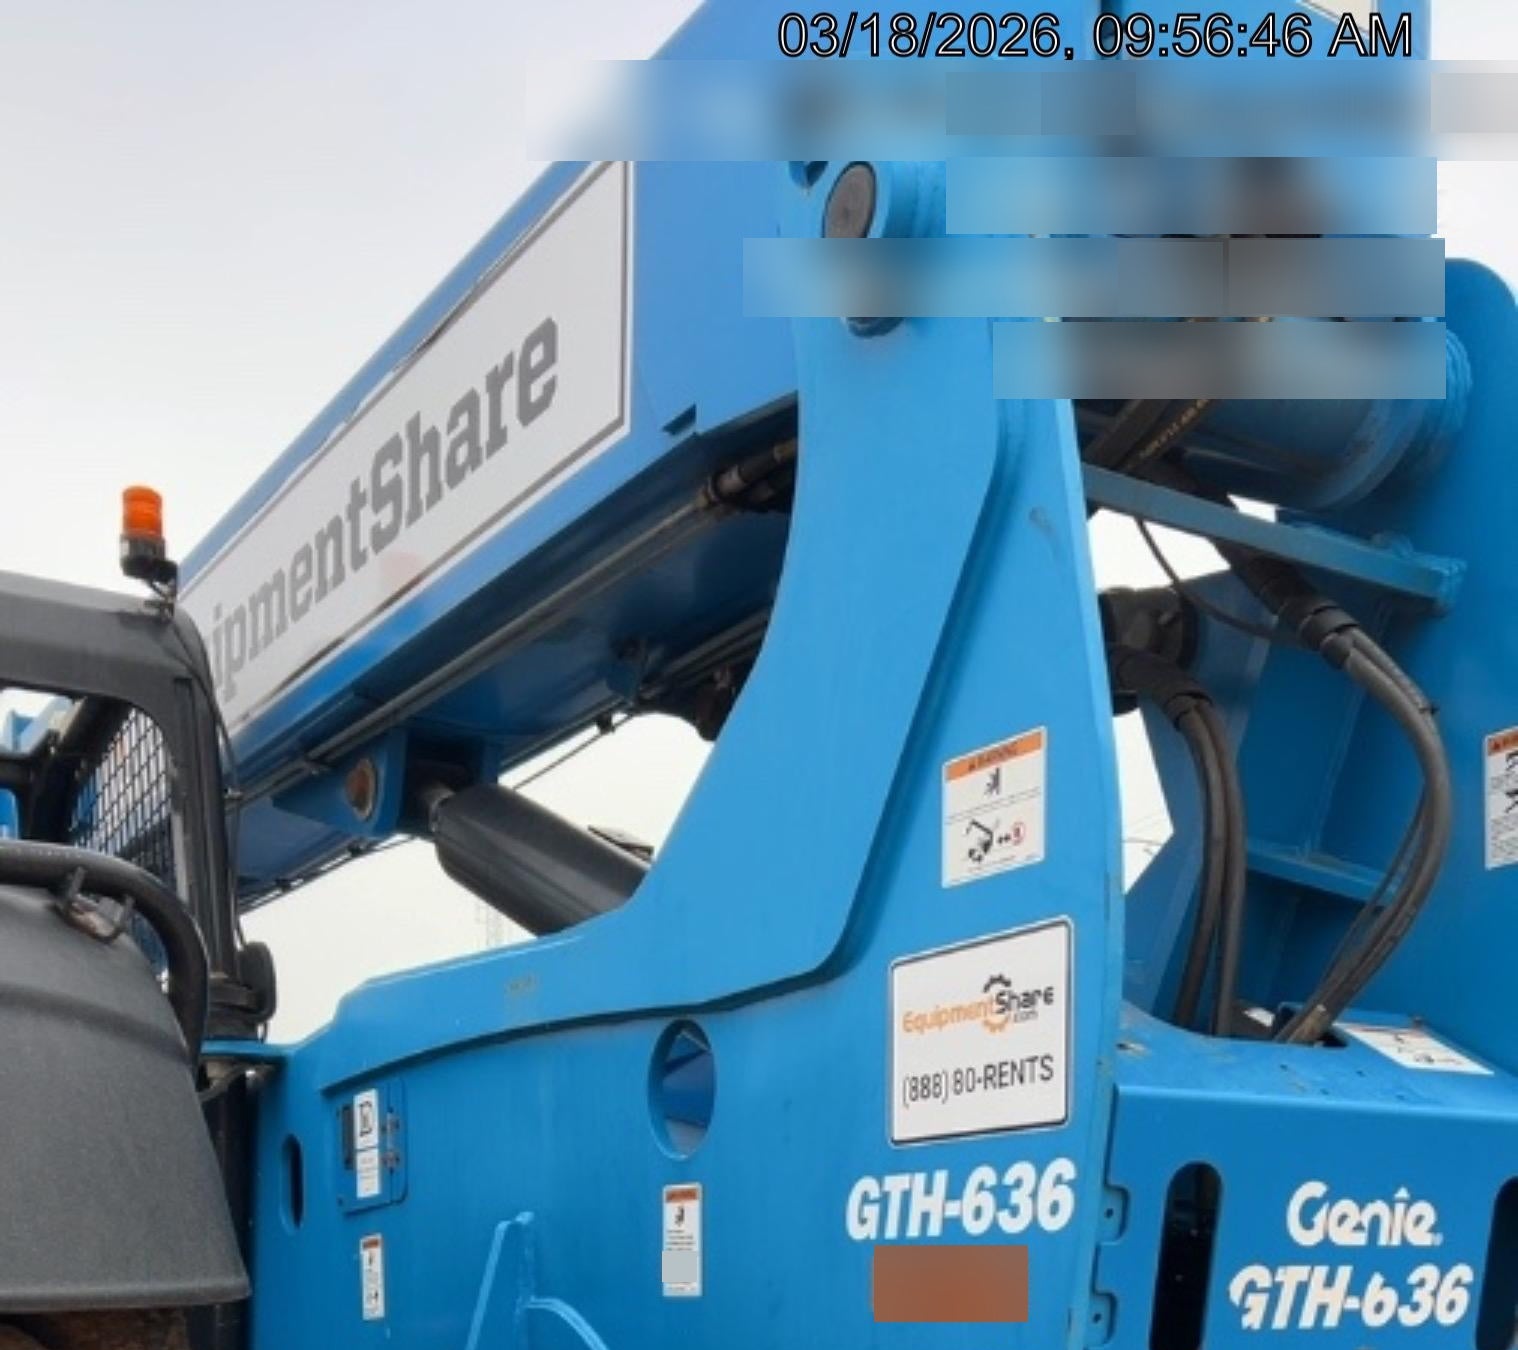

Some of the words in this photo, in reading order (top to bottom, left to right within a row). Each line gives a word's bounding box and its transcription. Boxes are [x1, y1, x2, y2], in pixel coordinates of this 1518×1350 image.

[204, 316, 558, 702] ipmentShare
[902, 1069, 948, 1109] (888)
[953, 1053, 1054, 1096] 80-RENTS
[845, 1157, 1077, 1241] GTH-636
[1228, 1263, 1475, 1331] GTH-636
